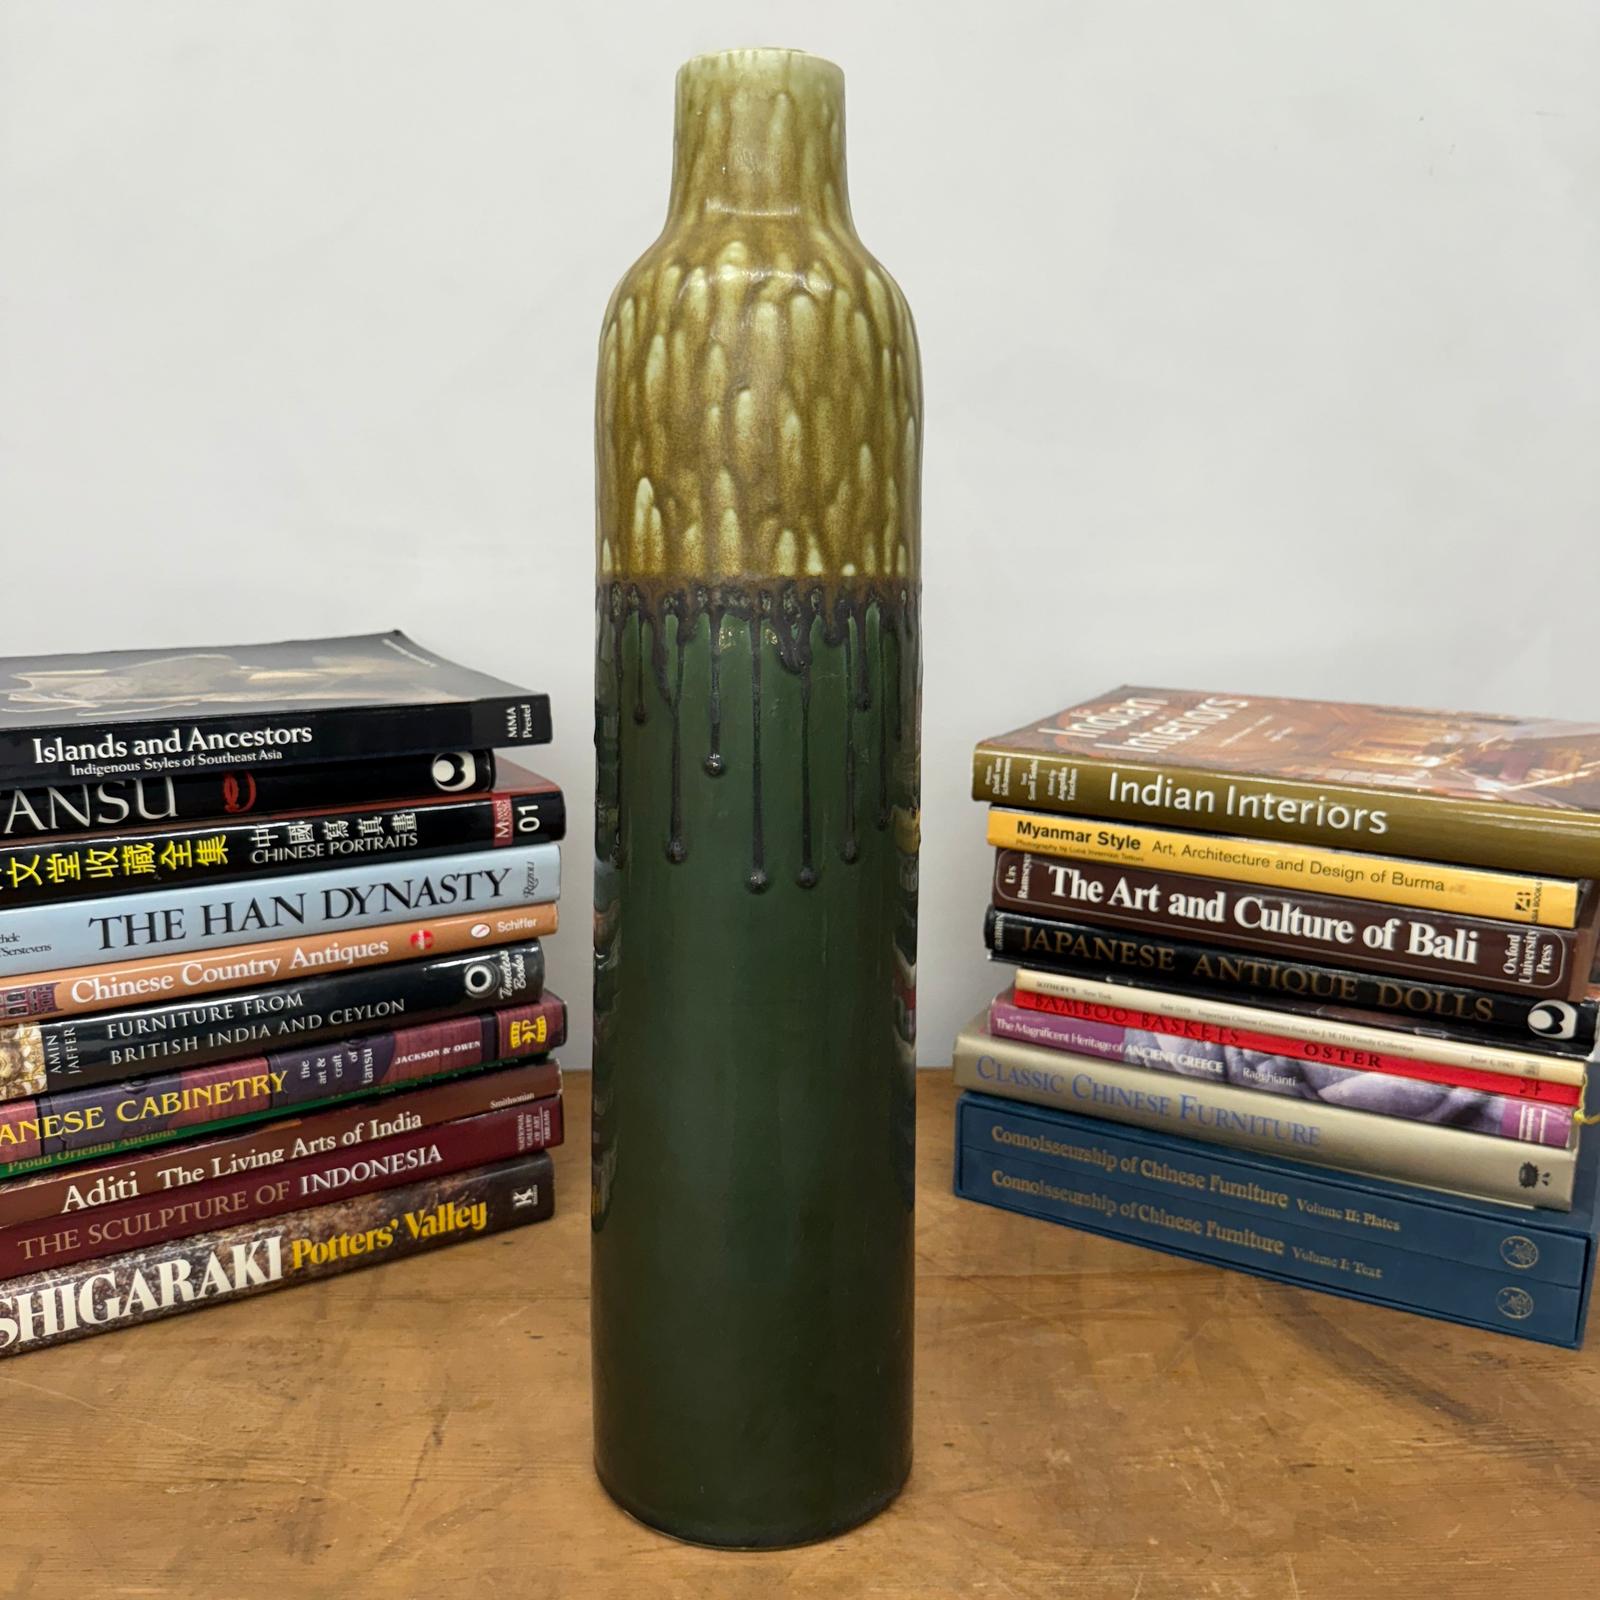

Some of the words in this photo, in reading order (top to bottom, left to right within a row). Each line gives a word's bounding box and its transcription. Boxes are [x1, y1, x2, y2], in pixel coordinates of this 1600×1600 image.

[507, 706, 517, 738] MMA
[522, 704, 533, 739] Prestel
[1038, 697, 1169, 738] Indian
[1093, 697, 1248, 754] Interiors
[33, 733, 128, 764] Islands
[134, 728, 183, 753] and
[188, 725, 313, 752] Ancestors
[71, 762, 141, 778] Indigenous
[144, 757, 180, 771] Styles
[183, 755, 196, 767] of
[198, 751, 257, 767] Southeast
[259, 749, 282, 761] Asia
[4, 776, 179, 834] ANSU
[517, 804, 541, 833] 01
[1109, 772, 1214, 813] Indian
[1226, 785, 1388, 835] Interiors
[0, 834, 229, 890] 文堂收藏全集
[252, 843, 324, 864] CHINESE
[331, 832, 418, 856] PORTRAITS
[1016, 821, 1091, 845] Myanmar
[1096, 831, 1141, 852] Style
[1152, 840, 1176, 857] Art,
[1181, 844, 1270, 869] Architecture
[1275, 857, 1304, 873] and
[1310, 861, 1364, 883] Design
[1370, 869, 1387, 884] of
[1392, 872, 1445, 893] Burma
[88, 908, 187, 950] THE
[201, 893, 306, 937] HAN
[321, 868, 512, 920] DYNASTY
[497, 917, 538, 933] Schiffer
[1048, 866, 1103, 903] The
[1107, 877, 1161, 912] Art
[1168, 891, 1226, 924] and
[1233, 896, 1354, 944] Culture
[1363, 918, 1402, 951] of
[1406, 921, 1479, 965] Bali
[71, 976, 174, 1004] Chinese
[181, 957, 281, 986] Country
[289, 940, 389, 970] Antiques
[513, 954, 527, 990] Books
[1022, 927, 1176, 971] JAPANESE
[1192, 955, 1357, 998] ANTIQUE
[1378, 982, 1495, 1022] DOLLS
[1503, 934, 1520, 975] Oxford
[1518, 929, 1539, 984] University
[1536, 944, 1552, 974] Press
[107, 1003, 235, 1040] FURNITURE
[244, 993, 303, 1017] FROM
[110, 1036, 198, 1065] BRITISH
[208, 1027, 271, 1048] INDIA
[278, 1014, 322, 1036] AND
[330, 998, 405, 1025] CEYLON
[1034, 993, 1128, 1024] BAMBOO
[1141, 1012, 1240, 1044] BASKETS
[47, 1033, 62, 1074] AMIN
[64, 1026, 81, 1074] JAFFER
[316, 1057, 327, 1068] &
[332, 1054, 343, 1078] craft
[348, 1051, 358, 1063] of
[395, 1048, 440, 1066] JACKSON
[453, 1040, 482, 1053] OWEN
[996, 1017, 1014, 1032] The
[1015, 1021, 1070, 1042] Magnificent
[1072, 1031, 1110, 1052] Heritage
[1112, 1041, 1124, 1053] of
[1124, 1043, 1175, 1064] ANCIENT
[1177, 1053, 1224, 1074] GREECE
[1304, 1043, 1381, 1068] OSTER
[301, 1060, 310, 1079] the
[318, 1070, 328, 1085] art
[1243, 1066, 1297, 1088] Ragghianti
[0, 1107, 105, 1145] ANESE
[116, 1070, 288, 1123] CABINETRY
[8, 1155, 52, 1172] Proud
[57, 1141, 115, 1161] Oriental
[120, 1129, 177, 1146] Auctions
[157, 1167, 205, 1190] The
[211, 1149, 284, 1179] Living
[291, 1134, 336, 1160] Arts
[342, 1124, 364, 1146] of
[369, 1111, 423, 1139] India
[61, 1171, 140, 1214] Aditi
[991, 1126, 1118, 1172] Connoisseurship
[1120, 1156, 1139, 1174] of
[1140, 1159, 1206, 1189] Chinese
[1209, 1173, 1289, 1209] Furniture
[1296, 1198, 1342, 1221] Volume
[1362, 1211, 1401, 1232] Plates
[18, 1229, 81, 1259] THE
[88, 1191, 249, 1245] SCULPTURE
[255, 1180, 290, 1204] OF
[300, 1144, 444, 1196] INDONESIA
[991, 1170, 1118, 1217] Connoisseurship
[1120, 1200, 1139, 1217] of
[1138, 1201, 1202, 1234] Chinese
[1206, 1215, 1285, 1255] Furniture
[1291, 1246, 1338, 1268] Volume
[1352, 1260, 1384, 1279] Text
[0, 1236, 283, 1348] SHIGARAKI
[291, 1218, 399, 1269] Potters'
[404, 1201, 487, 1240] Valley
